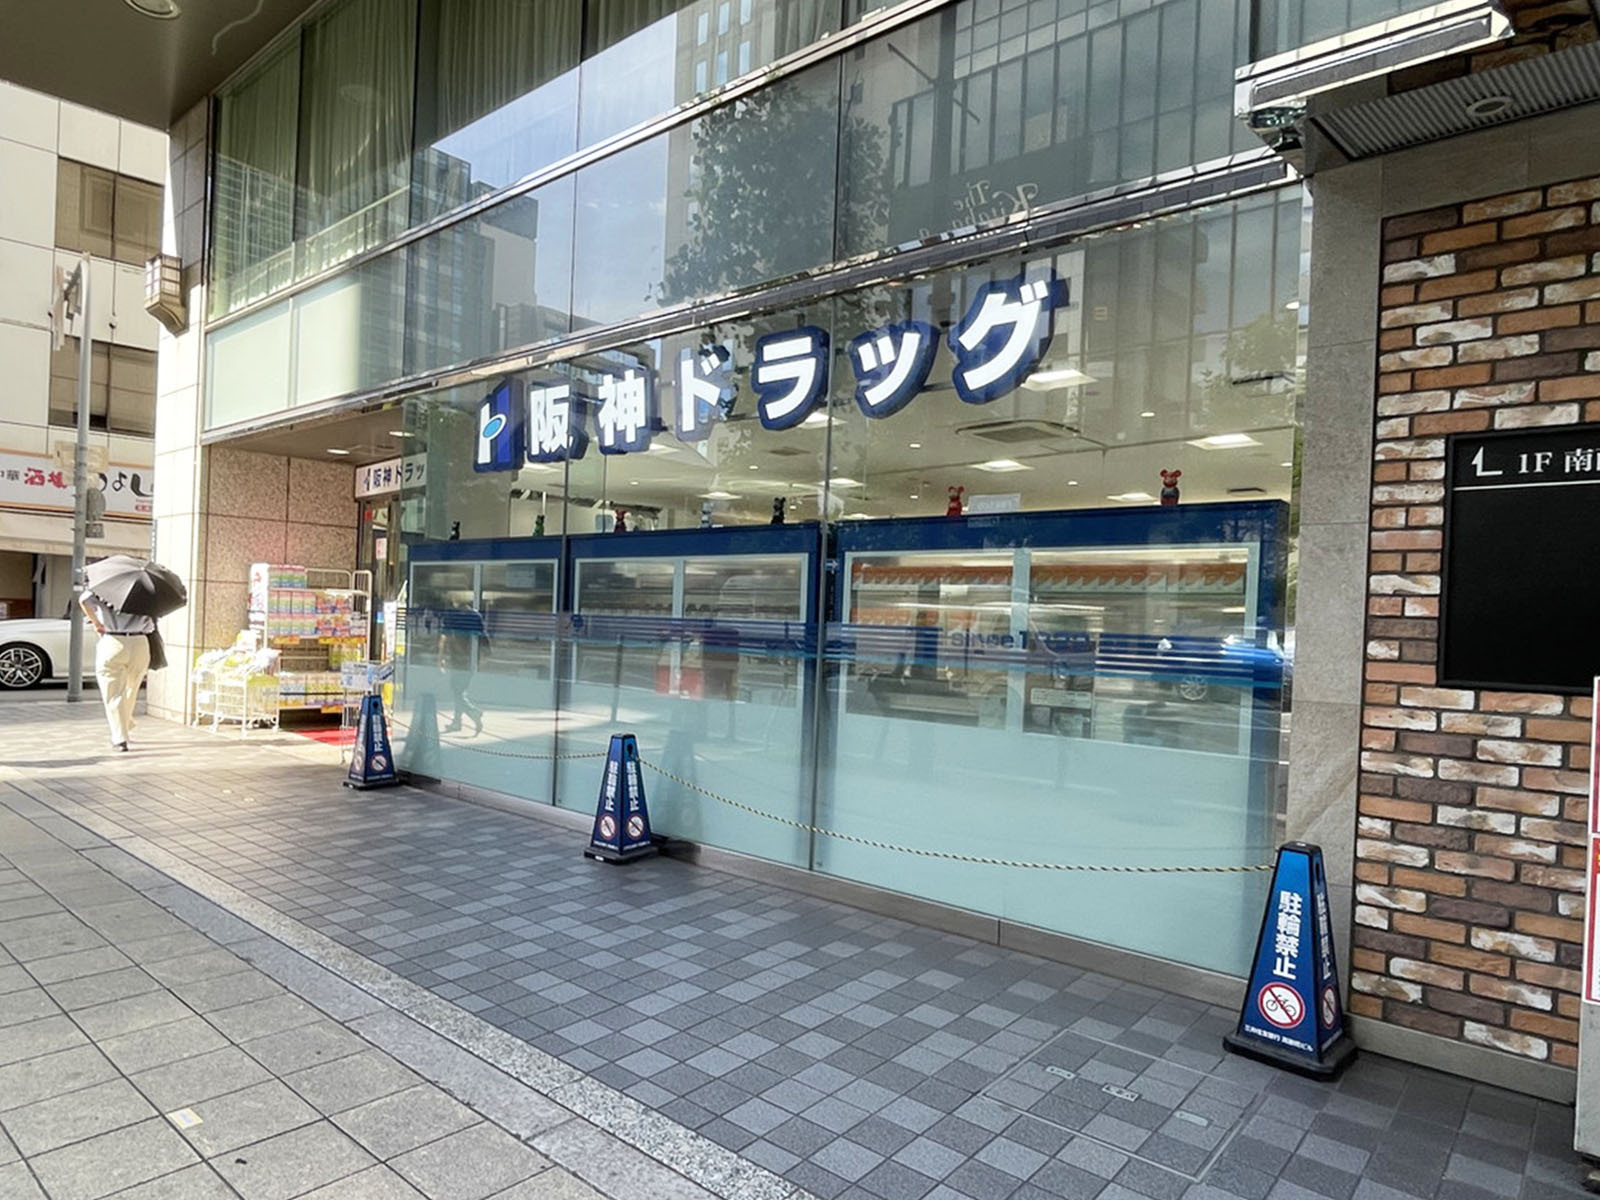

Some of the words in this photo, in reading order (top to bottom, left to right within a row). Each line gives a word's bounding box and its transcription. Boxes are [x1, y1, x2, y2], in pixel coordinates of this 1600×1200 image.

[529, 279, 1049, 455] 阪神ドラッグ
[1518, 452, 1553, 474] 1F
[1564, 448, 1600, 474] 南
[1272, 890, 1304, 981] 駐輪禁止
